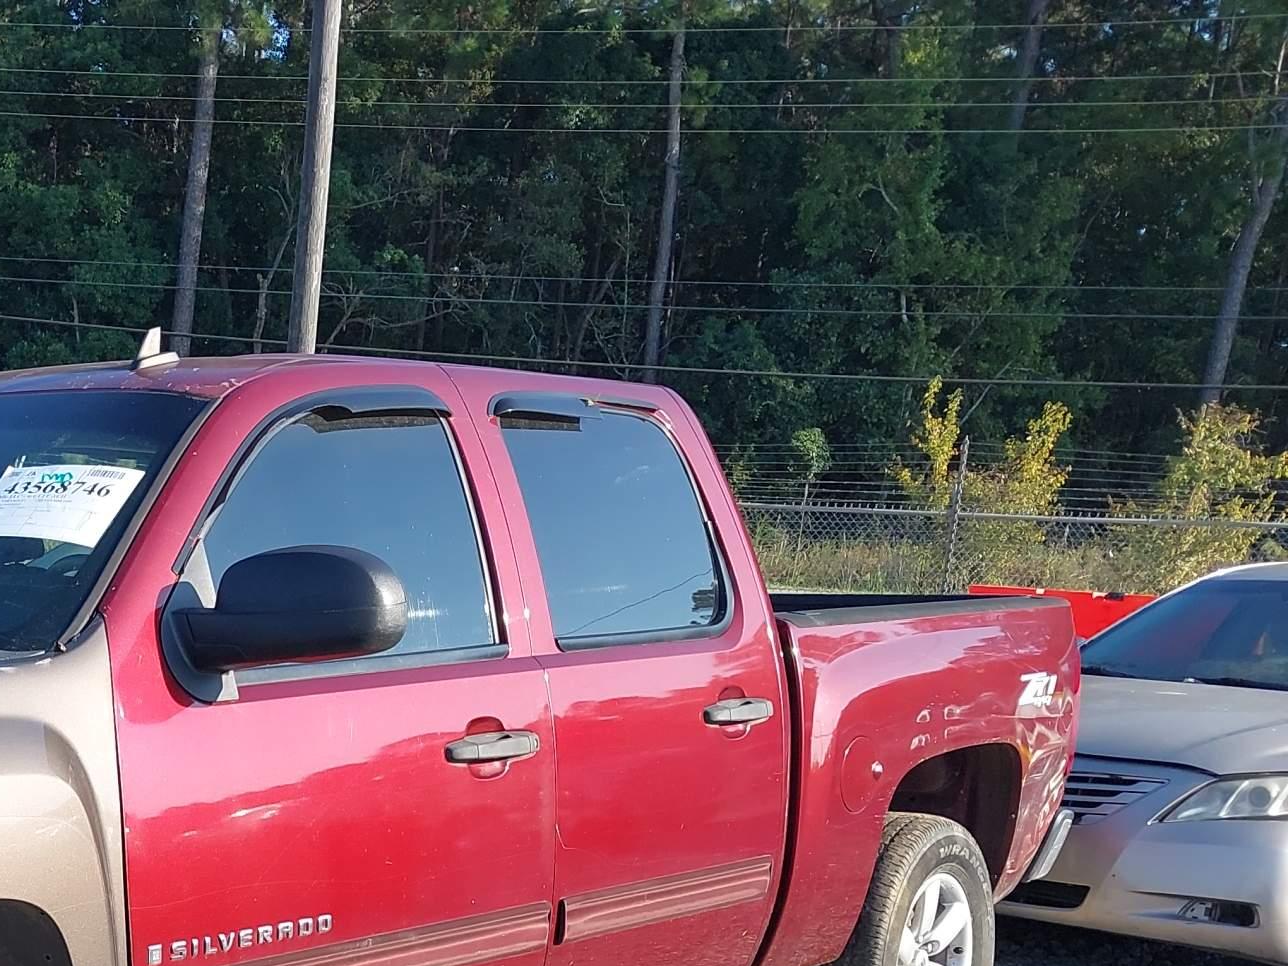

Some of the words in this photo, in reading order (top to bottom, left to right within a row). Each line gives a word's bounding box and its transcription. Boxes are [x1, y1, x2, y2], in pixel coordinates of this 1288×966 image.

[3, 480, 115, 498] 43568746
[1018, 671, 1058, 706] Z71
[169, 913, 334, 961] SILVERADO
